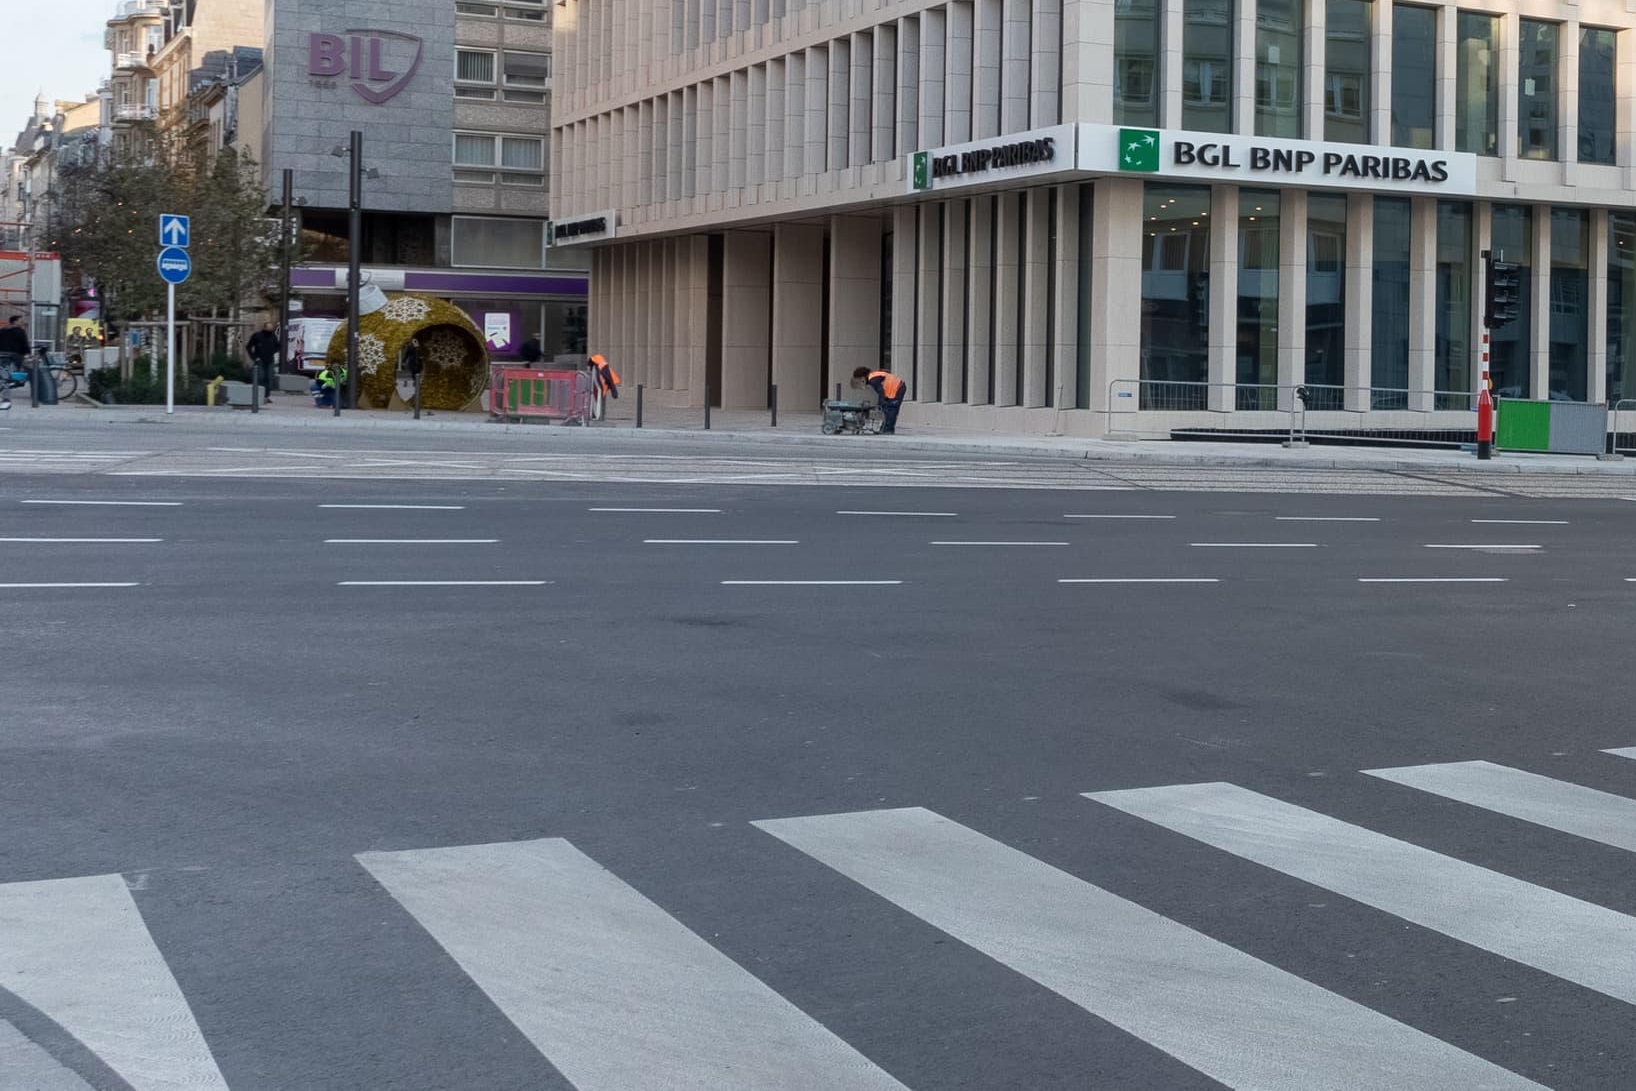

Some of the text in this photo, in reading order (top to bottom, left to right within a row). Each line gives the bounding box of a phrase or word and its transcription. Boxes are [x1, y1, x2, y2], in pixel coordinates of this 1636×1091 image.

[310, 33, 398, 81] BIL
[961, 149, 992, 172] BNP
[992, 137, 1055, 169] PARIBAS
[1174, 140, 1449, 182] BGL BNP PARIBAS
